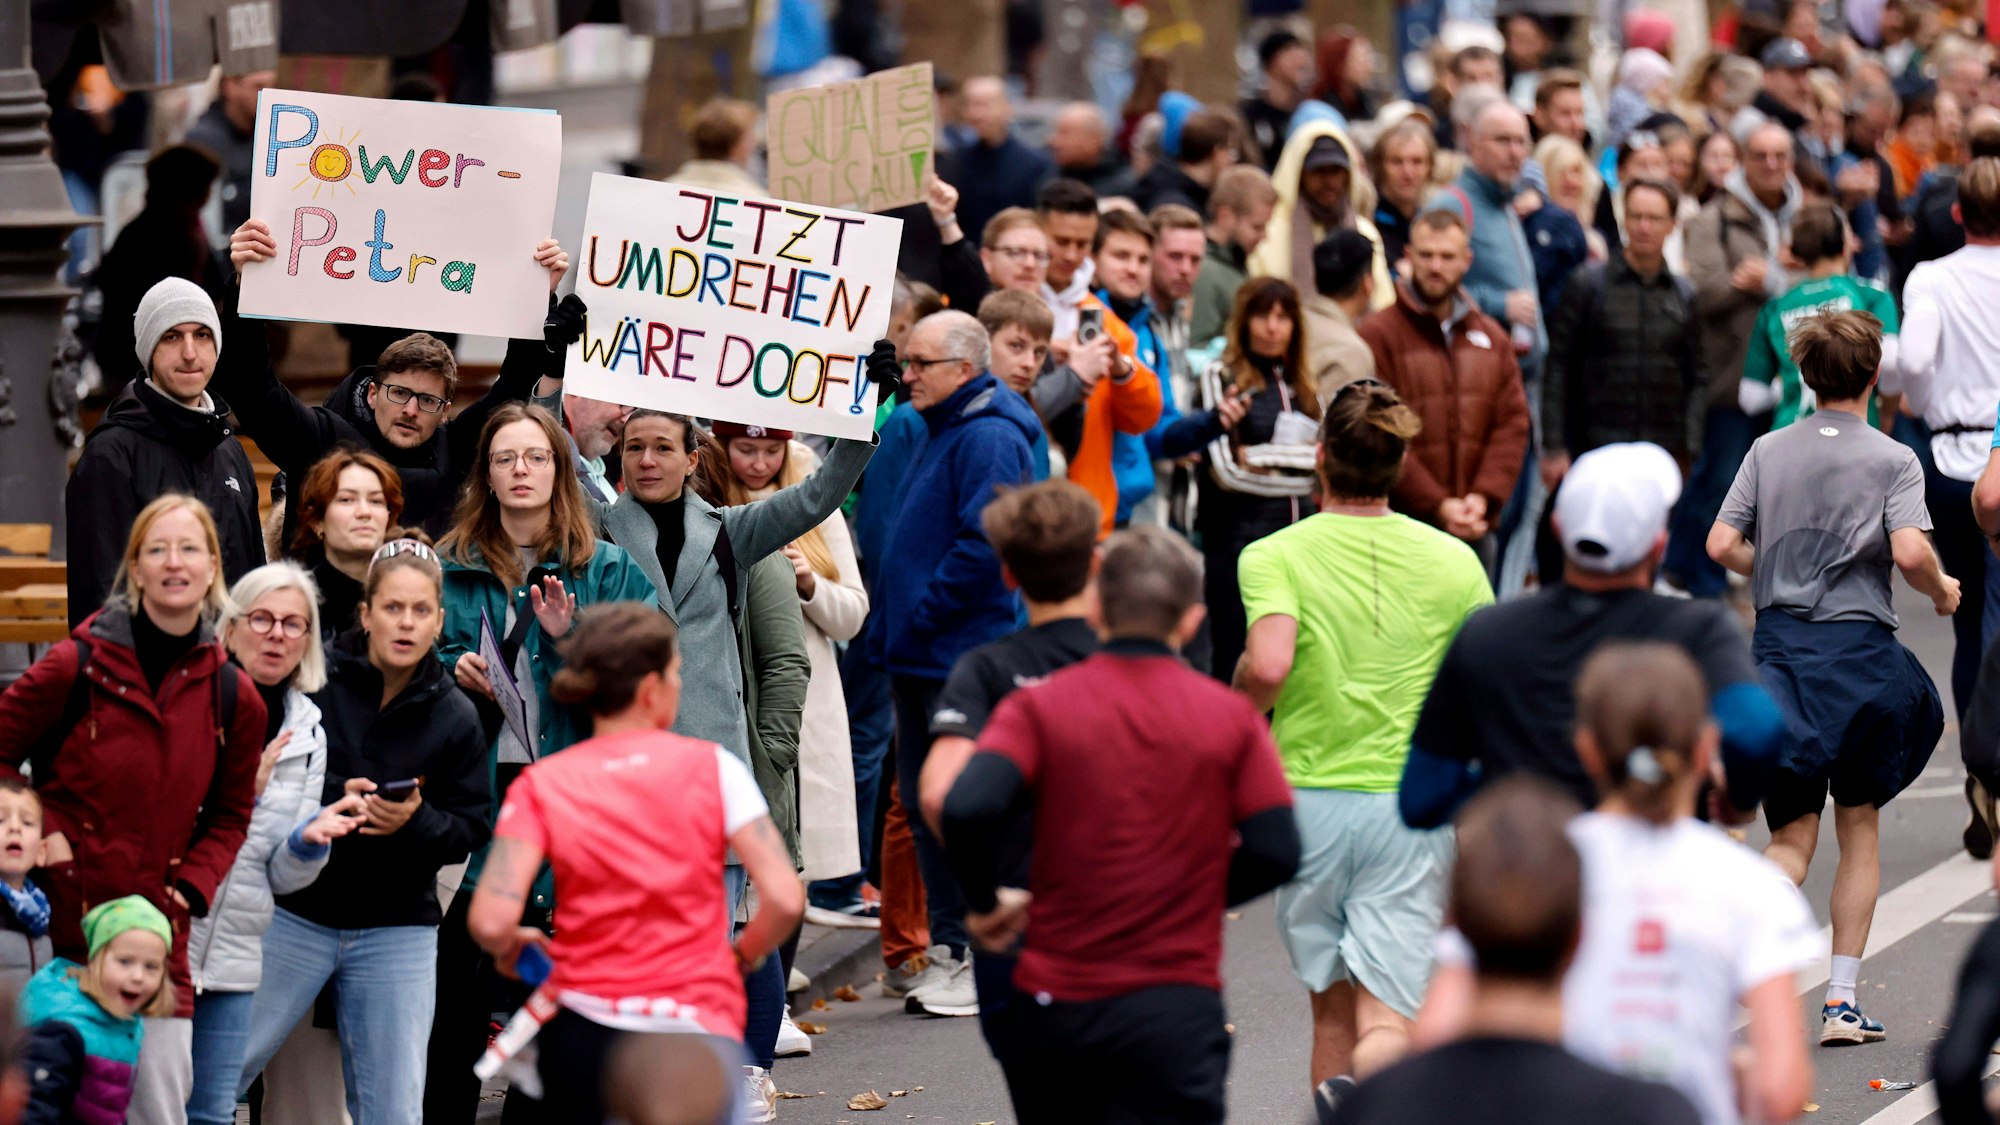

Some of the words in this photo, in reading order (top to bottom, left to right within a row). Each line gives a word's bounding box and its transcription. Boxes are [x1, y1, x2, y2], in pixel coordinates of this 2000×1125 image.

[266, 104, 521, 188] Power-
[287, 206, 477, 294] Petra
[676, 190, 865, 266] JETZT
[588, 235, 871, 332] UMDREHEN
[579, 314, 706, 382] WÄRE
[715, 333, 873, 415] DOOF!
